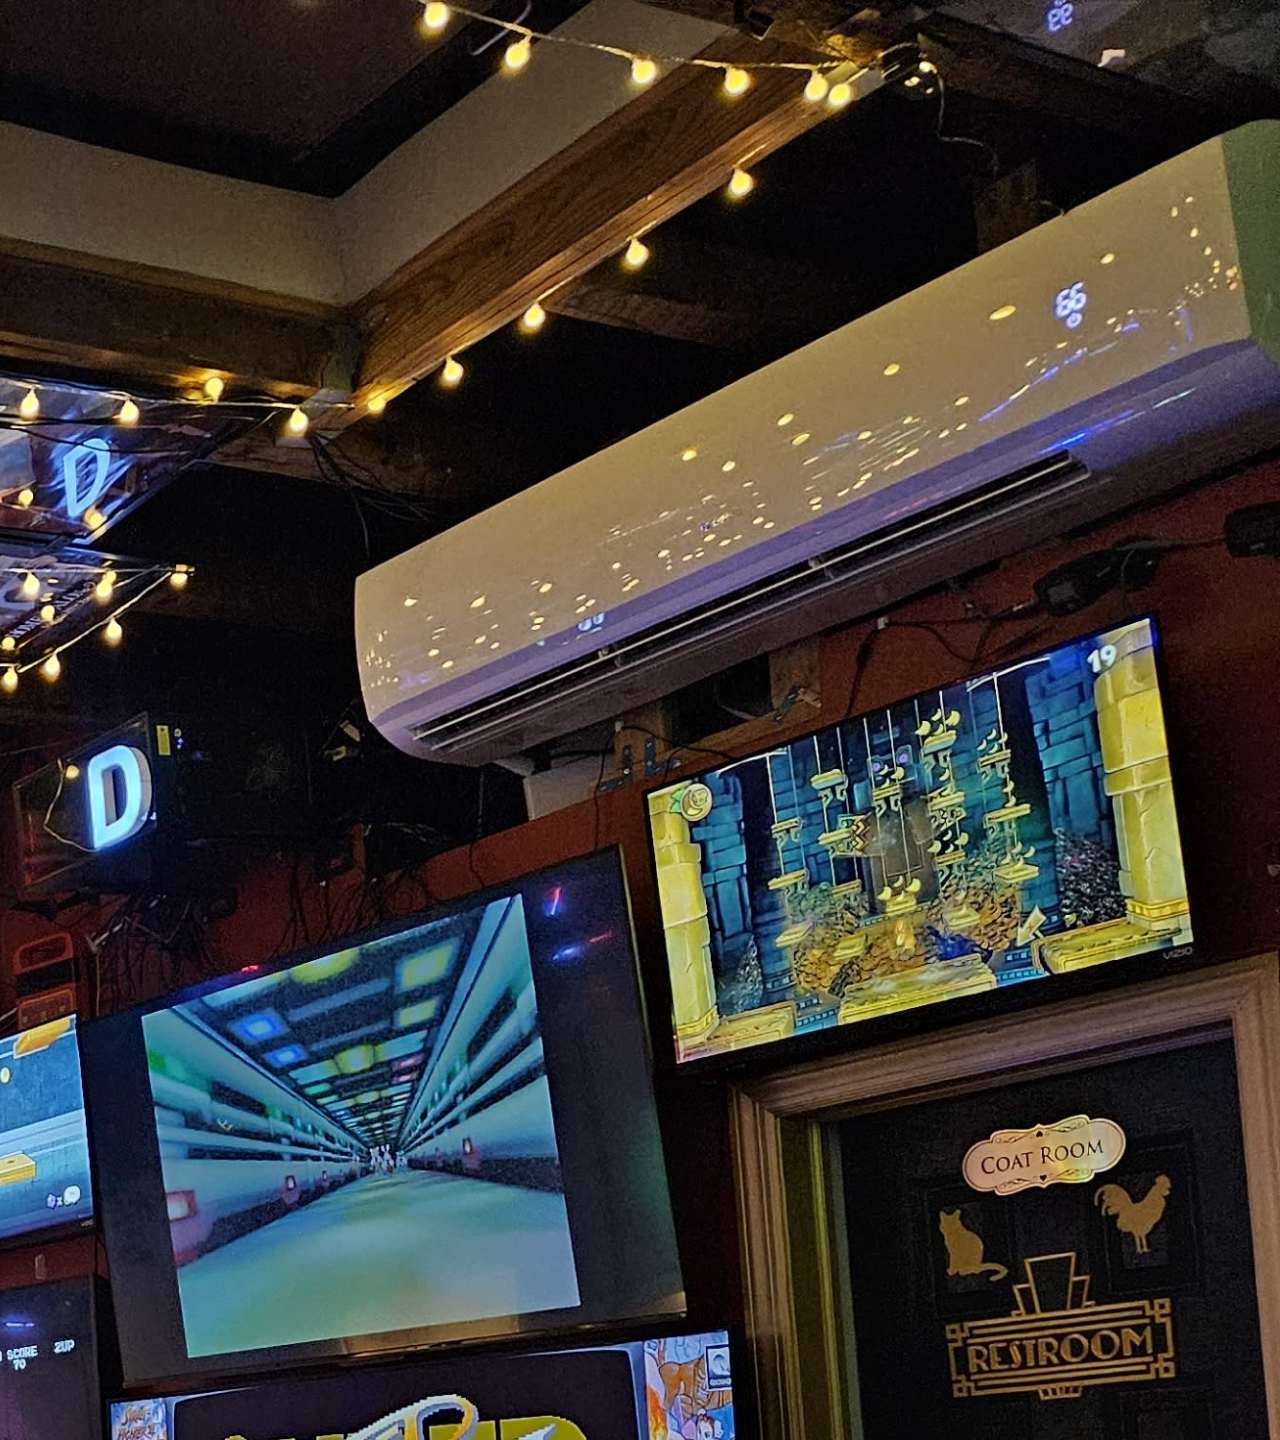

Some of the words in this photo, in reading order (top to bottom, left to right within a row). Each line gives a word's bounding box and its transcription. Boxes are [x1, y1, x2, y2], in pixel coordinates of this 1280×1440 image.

[1087, 645, 1117, 673] 19
[87, 745, 154, 853] D
[981, 1151, 1034, 1175] COAT
[1041, 1139, 1104, 1165] ROOM
[7, 1345, 38, 1360] SCORE
[54, 1339, 75, 1353] 2UP
[13, 1359, 26, 1370] 70
[968, 1326, 1153, 1373] RESTROOM
